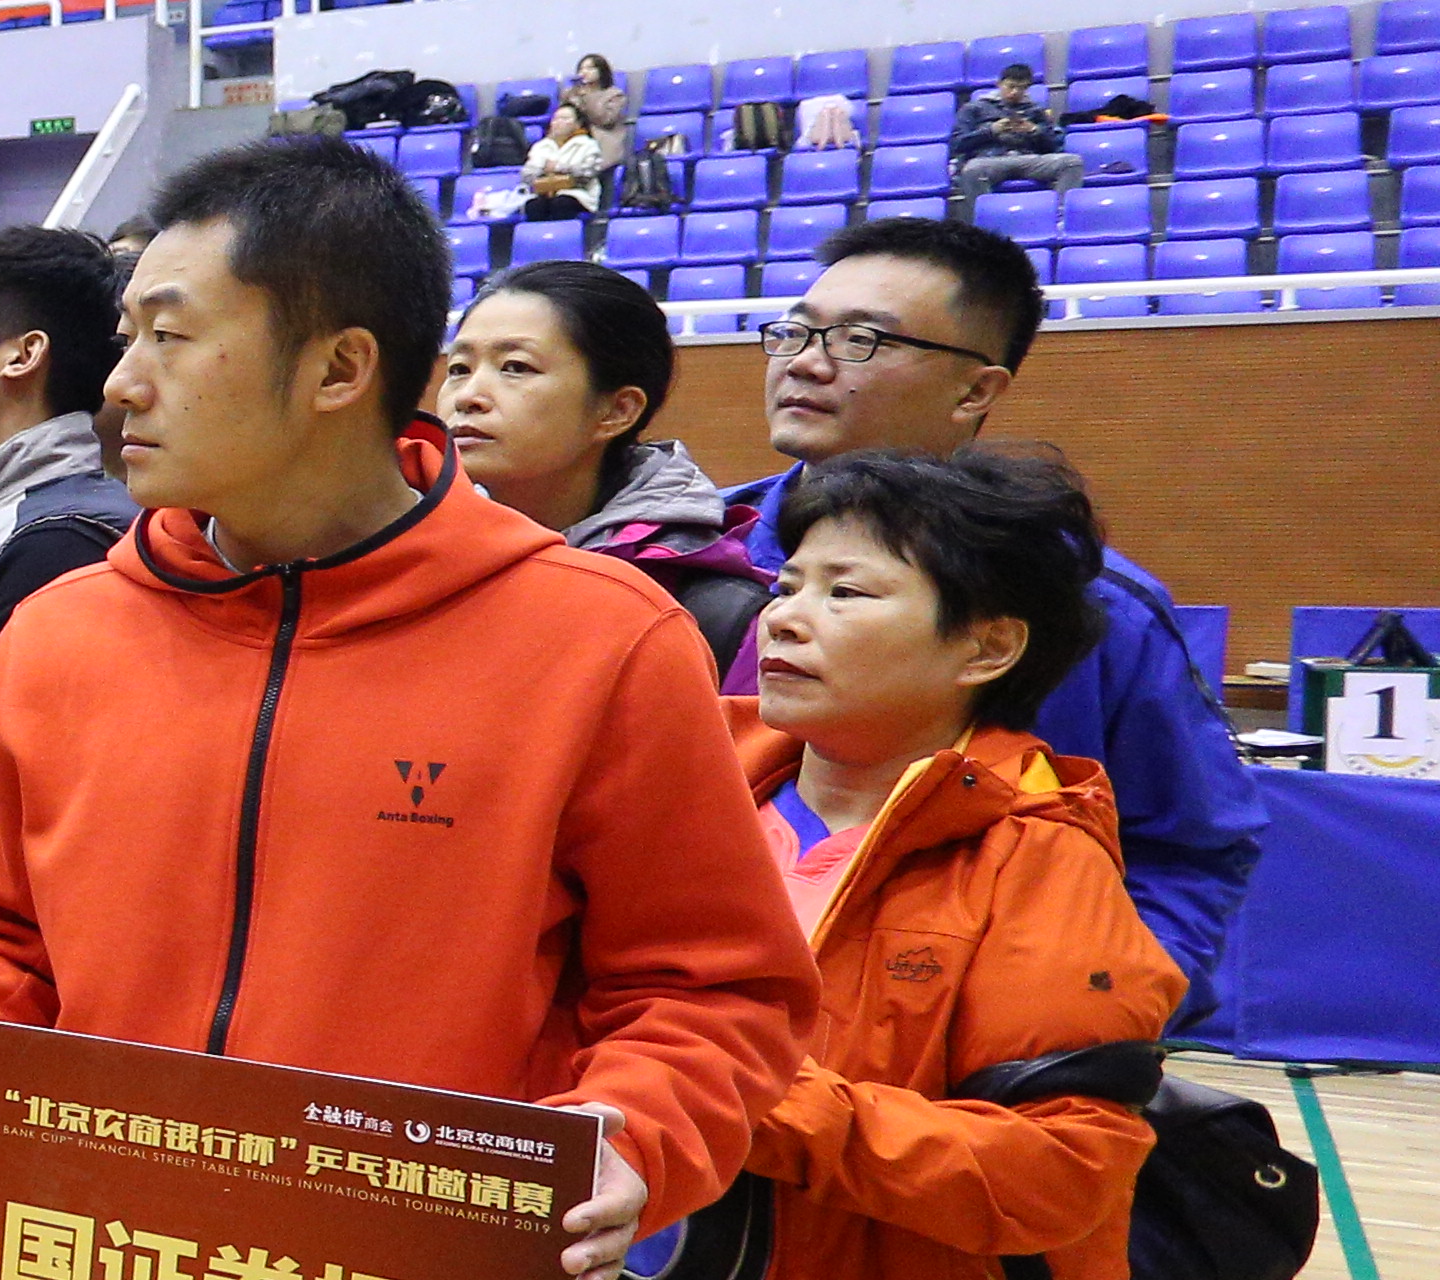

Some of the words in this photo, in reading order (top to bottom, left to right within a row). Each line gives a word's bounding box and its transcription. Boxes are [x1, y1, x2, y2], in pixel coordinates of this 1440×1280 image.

[1363, 685, 1406, 740] 1
[436, 1125, 556, 1158] 北京农商银行
[3, 1124, 36, 1140] BANK
[78, 1139, 147, 1160] FINANCIAL
[153, 1152, 196, 1168] STREET
[201, 1160, 240, 1177] TABLE
[246, 1169, 292, 1187] TENNIS
[298, 1178, 398, 1206] INVITATIONAL
[405, 1198, 508, 1226] TOURNAMENT
[514, 1218, 551, 1235] 2019
